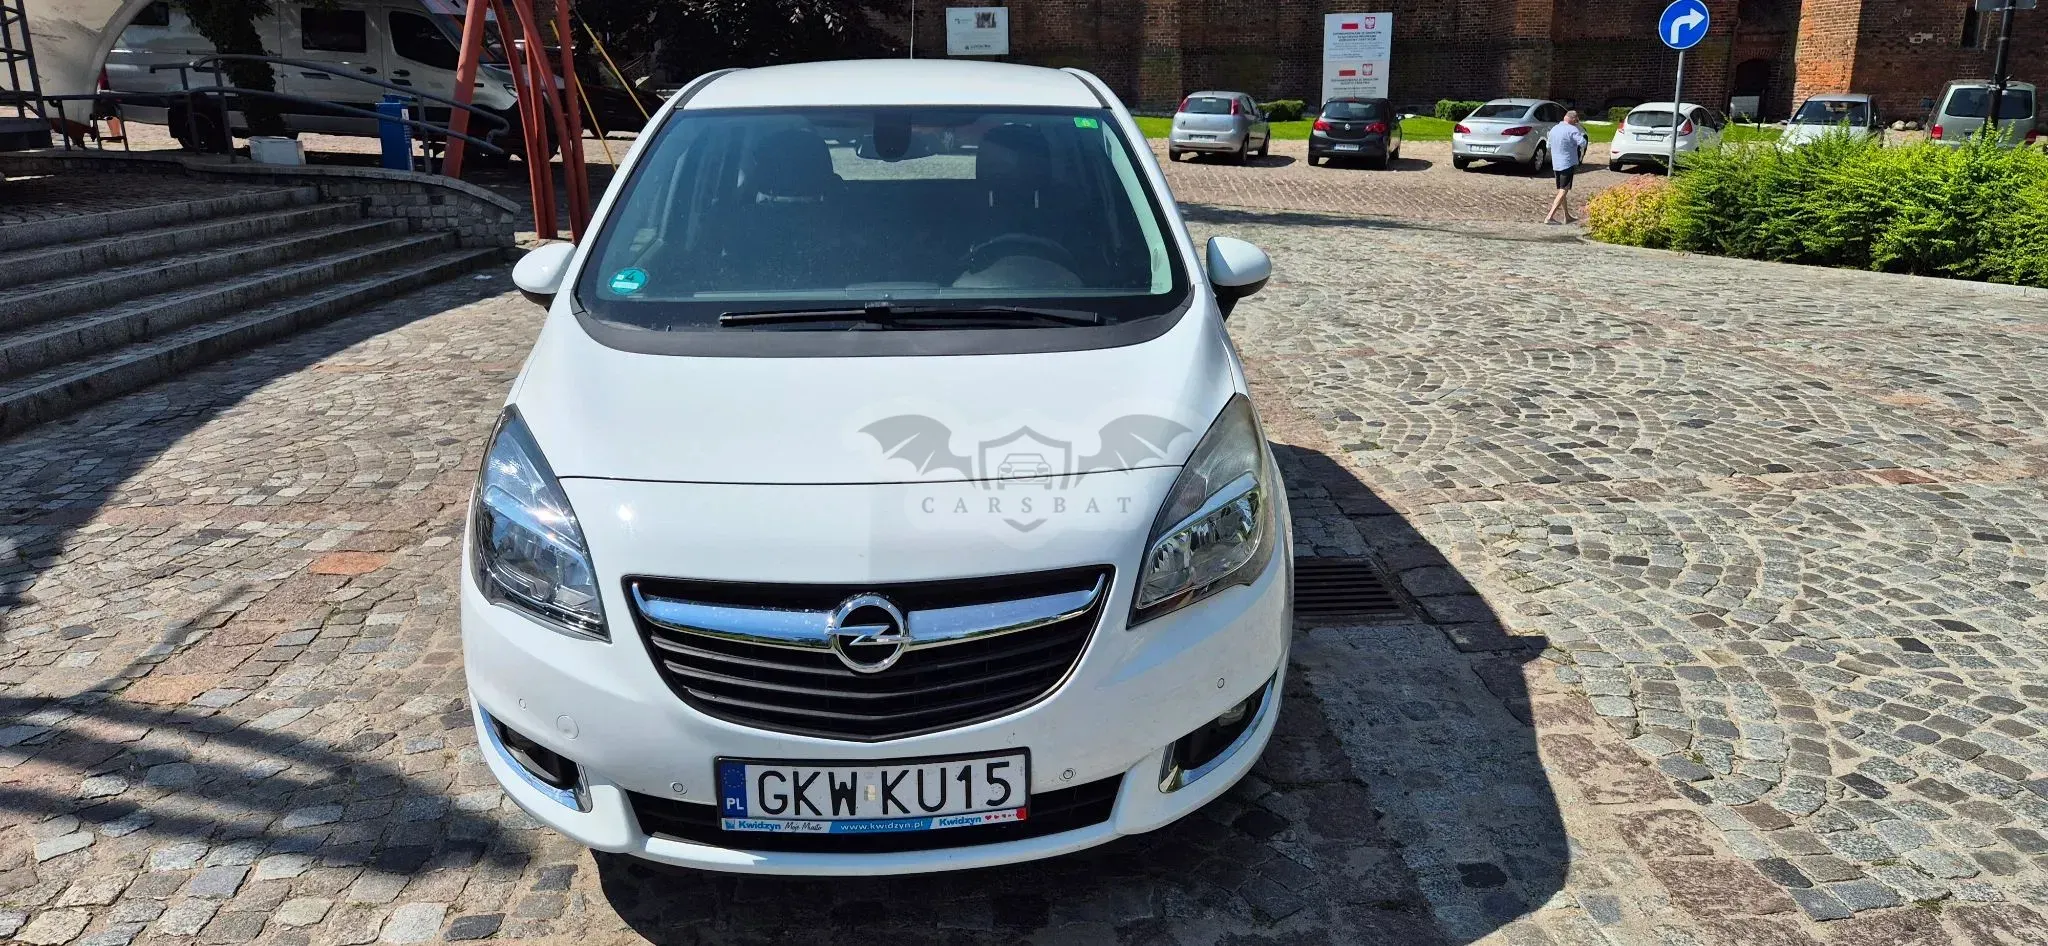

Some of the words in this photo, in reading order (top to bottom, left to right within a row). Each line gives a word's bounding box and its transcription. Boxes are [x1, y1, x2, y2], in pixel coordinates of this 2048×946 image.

[758, 769, 858, 817] GKW
[881, 761, 1012, 815] KU15
[726, 797, 745, 811] PL
[738, 820, 781, 832] Kwidzyn
[840, 821, 924, 831] www.kwidzyn.pl
[939, 816, 982, 827] Kwidzyn
